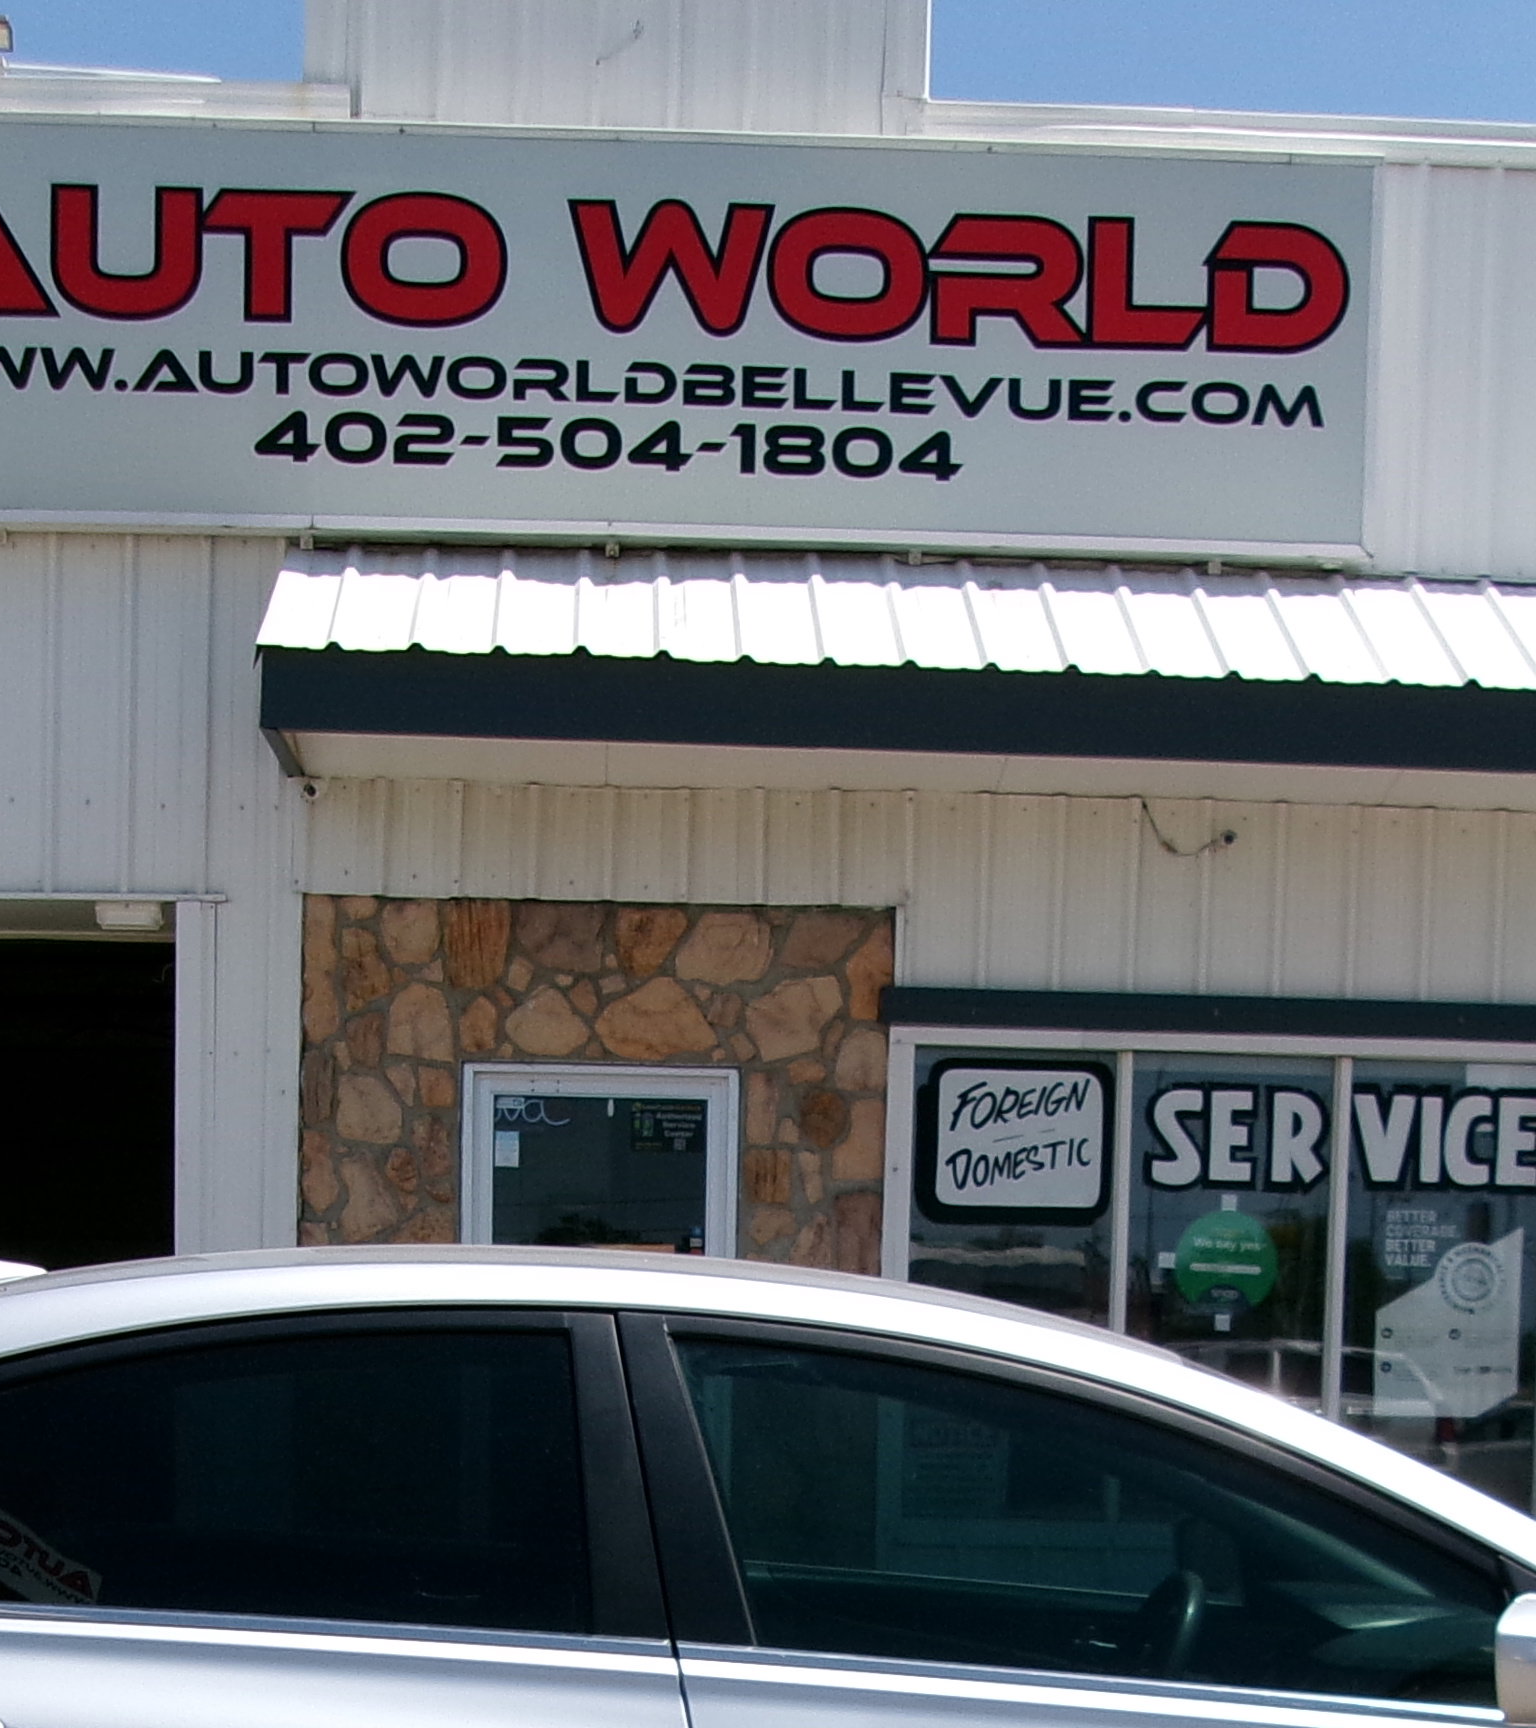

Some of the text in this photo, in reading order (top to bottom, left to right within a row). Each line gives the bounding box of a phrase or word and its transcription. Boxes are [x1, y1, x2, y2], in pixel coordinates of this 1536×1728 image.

[567, 197, 1351, 353] WORLD
[254, 409, 963, 481] 402-504-1804
[949, 1078, 1091, 1131] FOREIGN
[945, 1138, 1091, 1190] DOMESTIC
[1193, 1236, 1213, 1248] We
